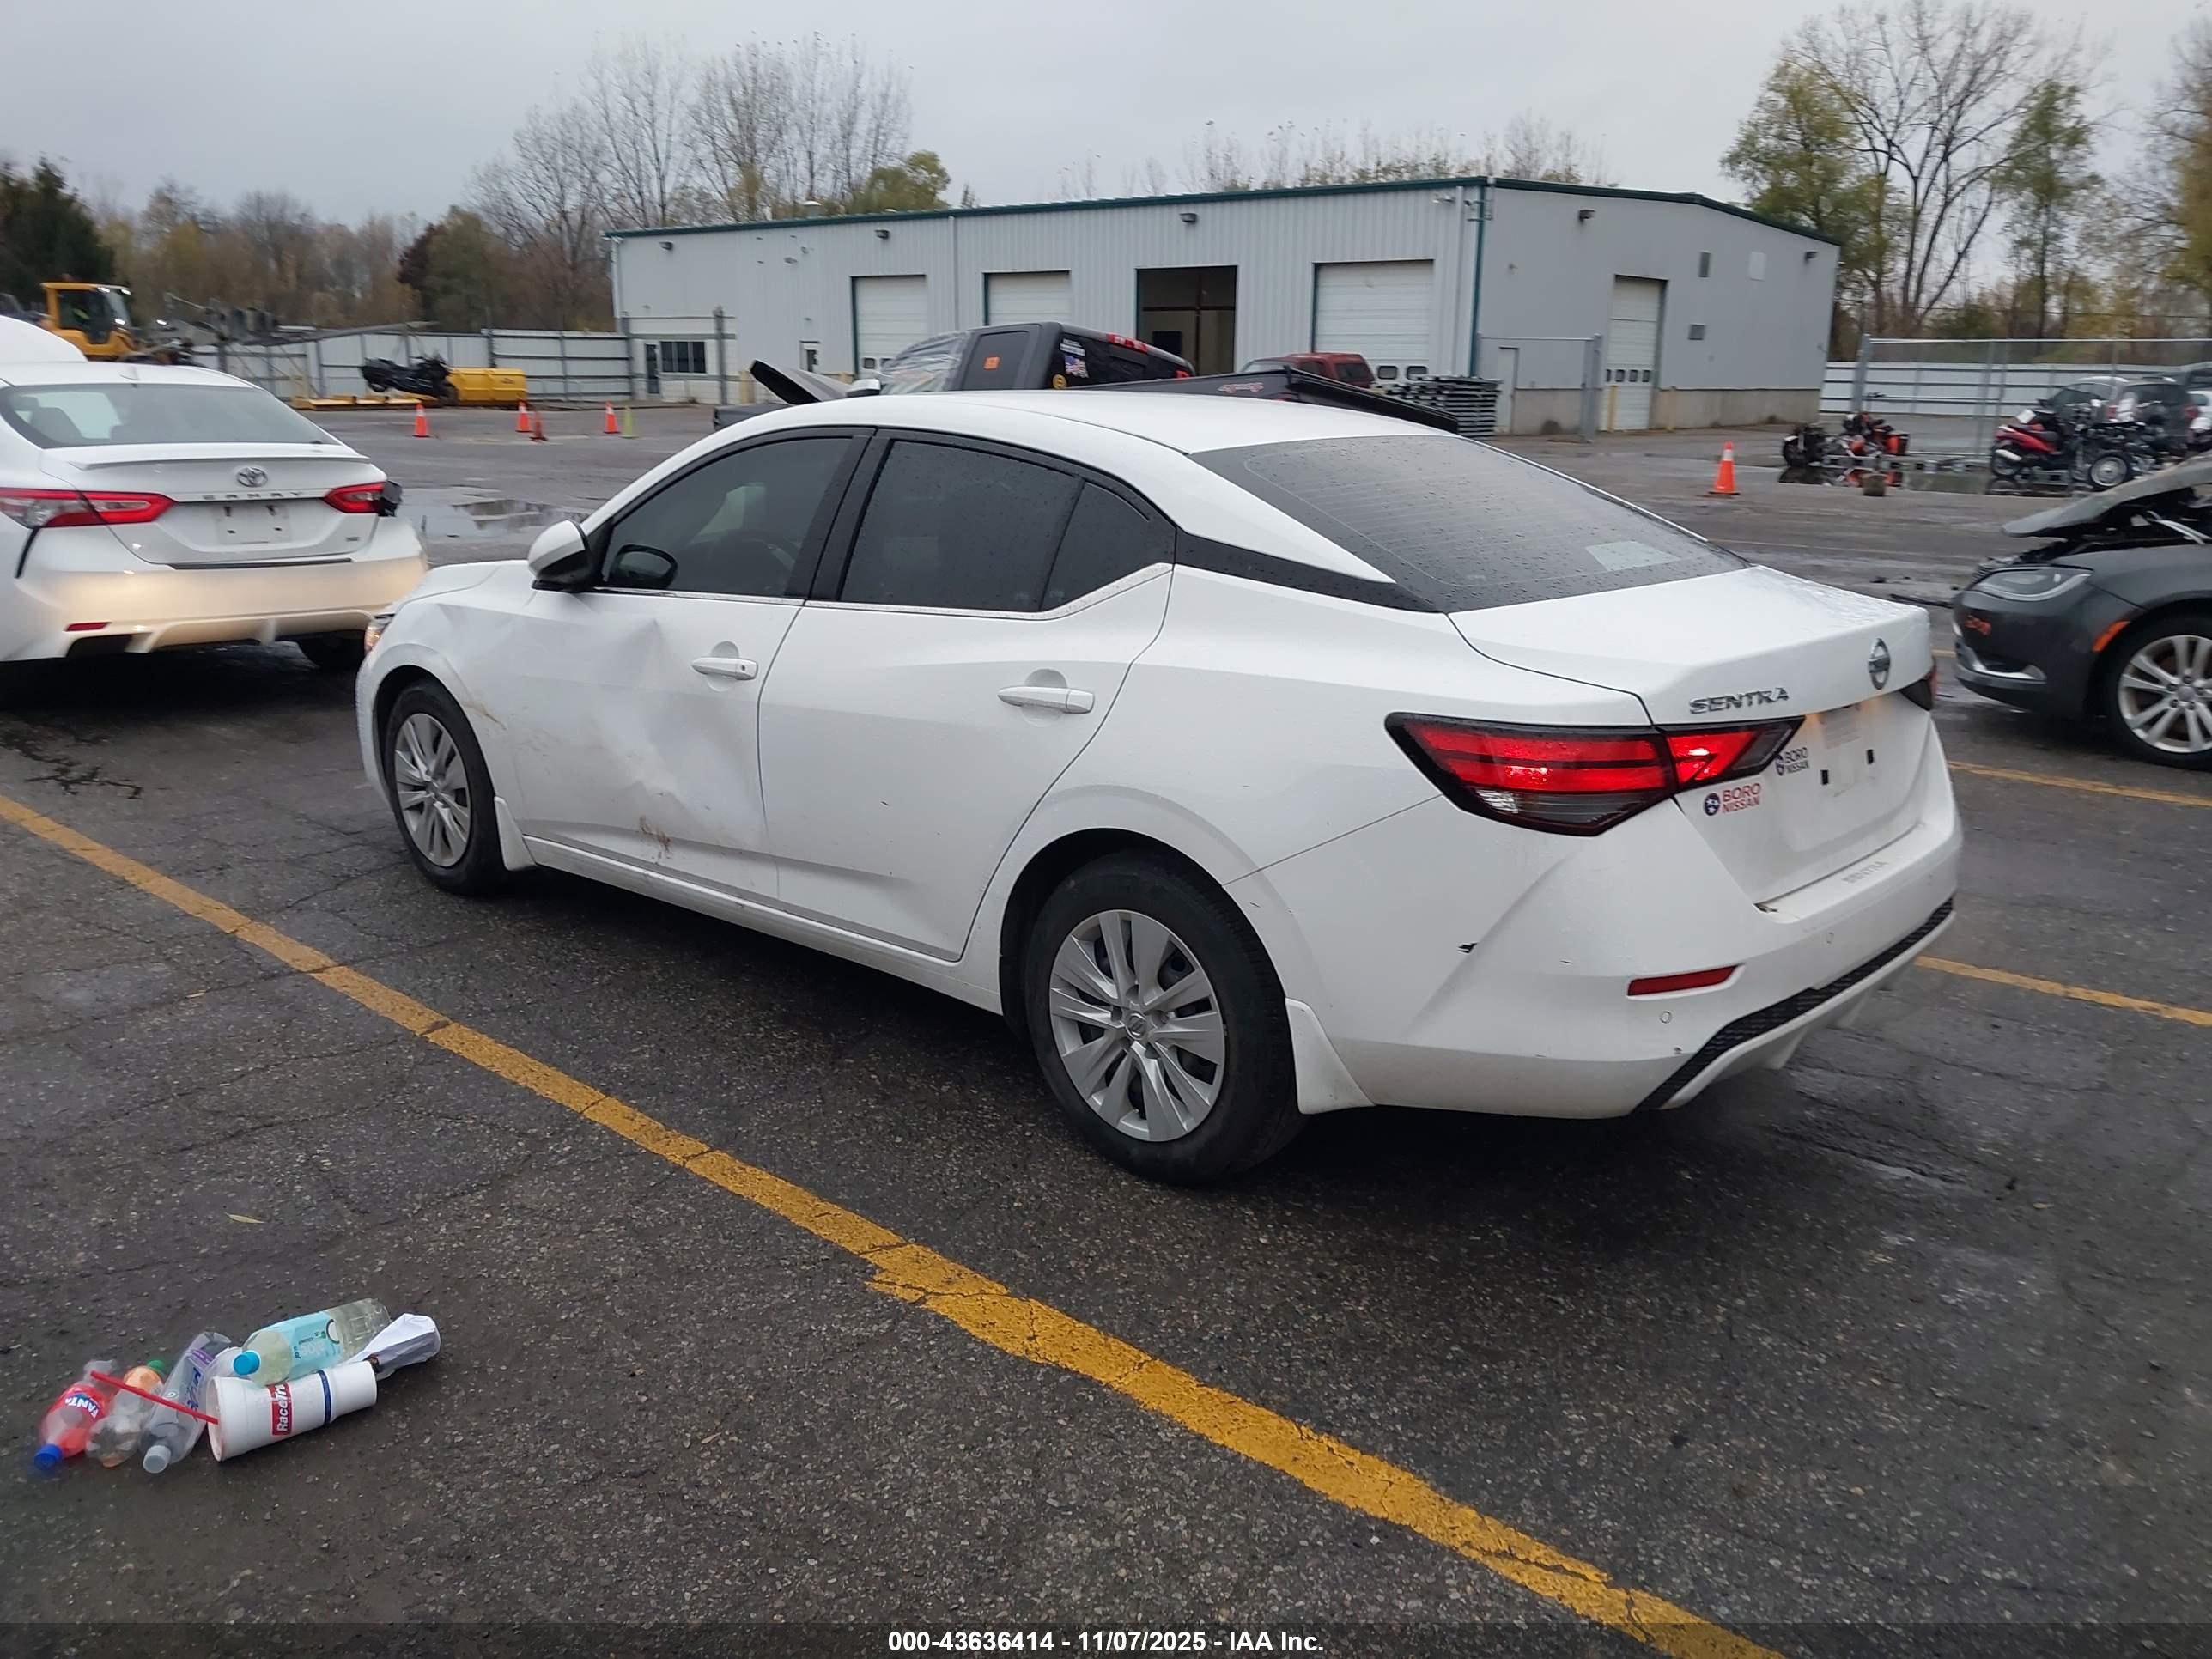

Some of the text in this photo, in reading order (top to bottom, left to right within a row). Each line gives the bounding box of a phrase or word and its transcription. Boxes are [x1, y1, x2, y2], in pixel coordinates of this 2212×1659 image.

[1690, 687, 1789, 714] SENTRA
[1785, 747, 1808, 763] BORO
[1723, 783, 1760, 802] BORO
[1723, 797, 1759, 813] NISSAN
[64, 1396, 99, 1419] FANTA
